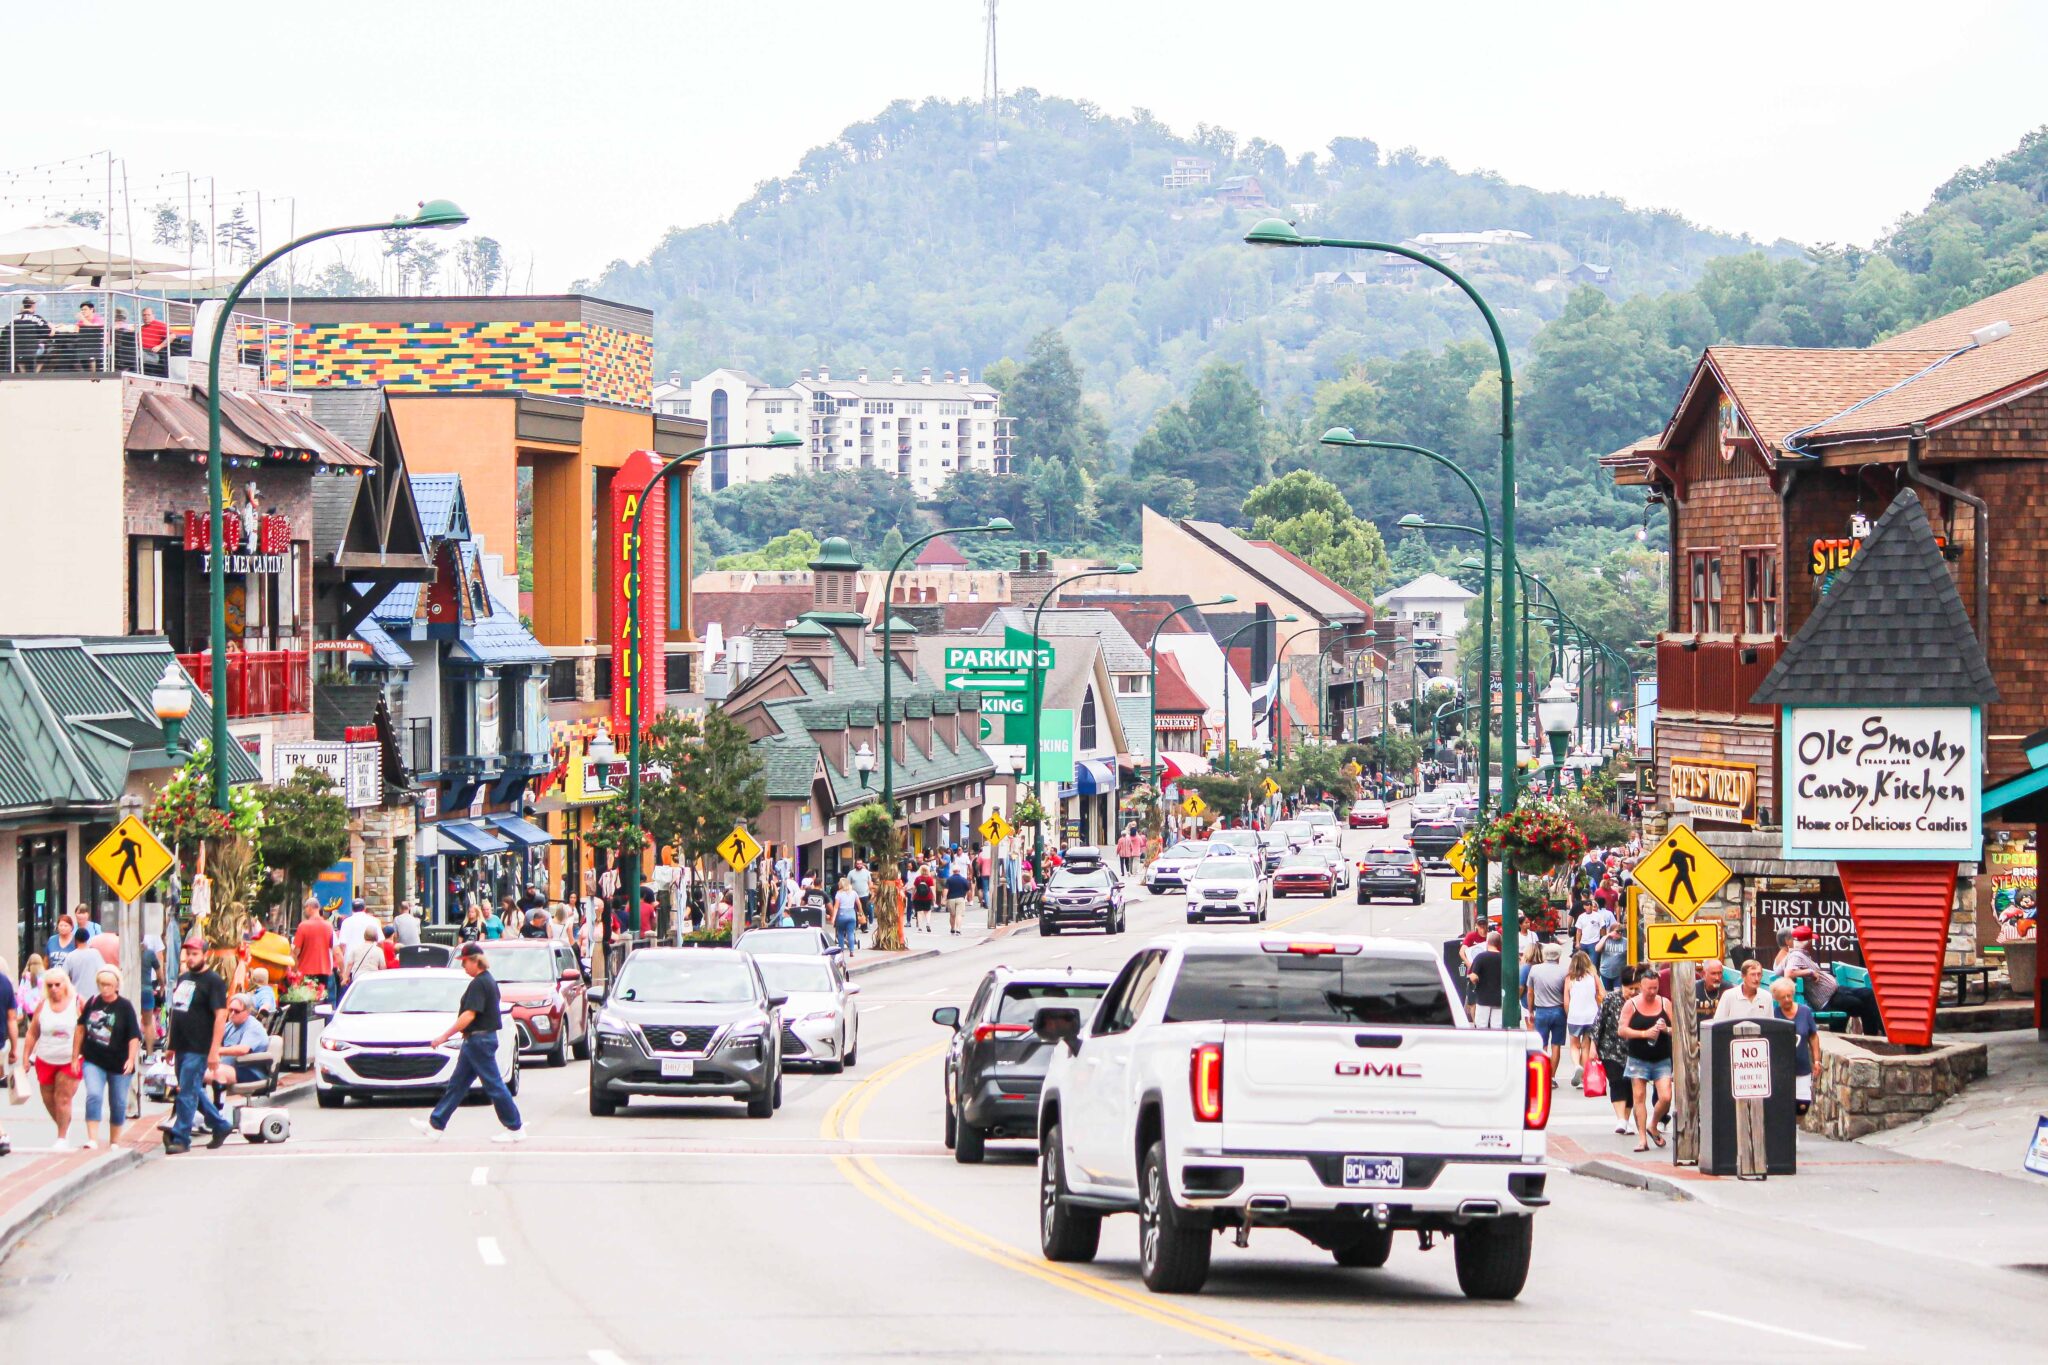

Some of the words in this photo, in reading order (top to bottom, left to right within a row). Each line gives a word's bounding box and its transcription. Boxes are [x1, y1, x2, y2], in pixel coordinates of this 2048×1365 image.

[233, 555, 250, 573] MEX
[253, 555, 286, 574] CANTINA
[1812, 538, 1862, 575] STEA
[314, 641, 364, 649] JONATHAN'S
[951, 650, 1050, 667] PARKING
[982, 699, 1024, 712] KING
[1040, 739, 1069, 752] KING
[1798, 729, 1854, 765] Ole
[1856, 716, 1966, 777] Smoky
[285, 754, 306, 764] TRY
[317, 753, 338, 764] OUR
[1670, 765, 1706, 801] GIFTS
[1708, 768, 1752, 810] WORLD
[1798, 773, 1869, 814] Candy
[1868, 768, 1965, 814] Kitchen
[1797, 815, 1831, 831] Home
[1852, 816, 1912, 831] Delicious
[1916, 816, 1968, 832] Candies
[1991, 853, 2037, 864] UPSTA
[1761, 900, 1813, 916] FIRST
[1818, 901, 1850, 916] UNI
[1741, 1047, 1759, 1058] NO
[1334, 1060, 1423, 1078] GMC
[1733, 1061, 1768, 1069] PARKING
[1346, 1164, 1366, 1180] BCN
[1374, 1164, 1400, 1180] 3900
